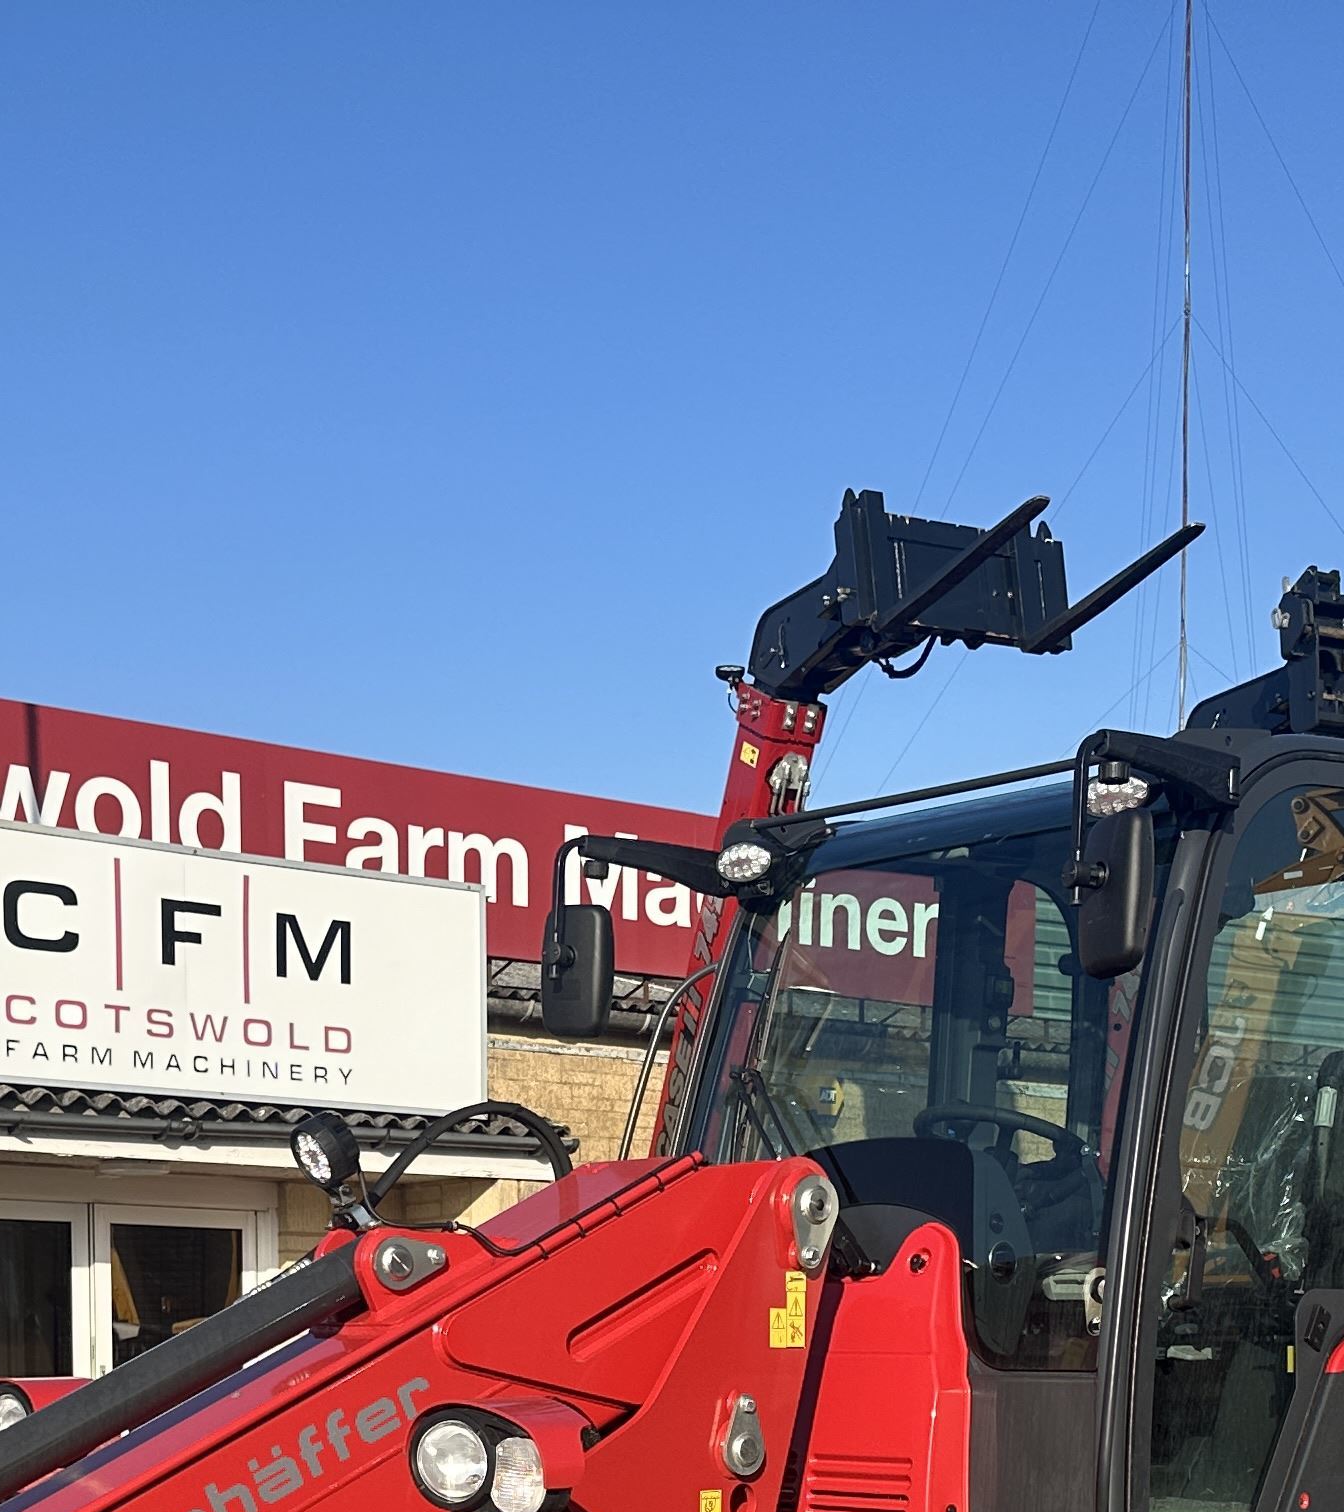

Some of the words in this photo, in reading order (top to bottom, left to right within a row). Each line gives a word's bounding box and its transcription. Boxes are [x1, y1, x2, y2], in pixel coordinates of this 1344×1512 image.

[282, 779, 529, 908] Farm
[4, 994, 353, 1054] COTSWOLD
[6, 1039, 113, 1066] FARM
[133, 1050, 353, 1085] MACHINERY
